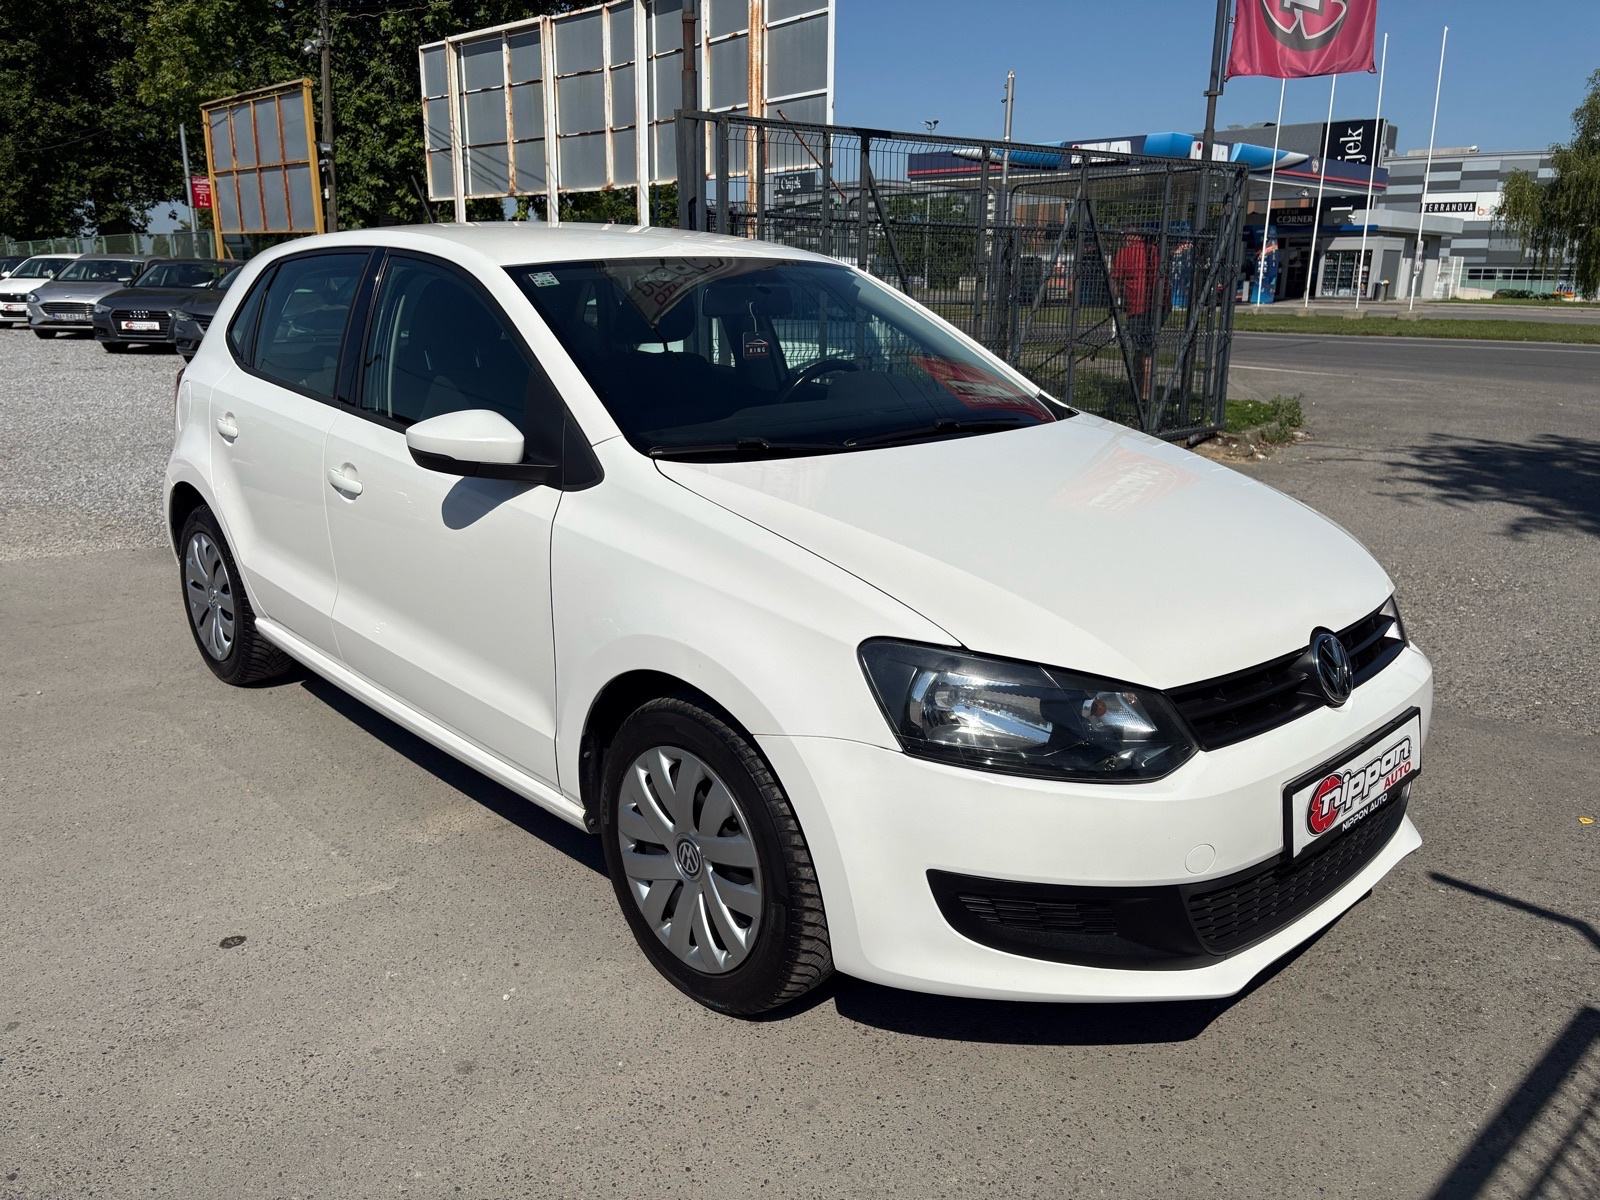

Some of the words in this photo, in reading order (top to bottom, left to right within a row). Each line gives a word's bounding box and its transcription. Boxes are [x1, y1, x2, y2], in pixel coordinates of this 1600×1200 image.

[1424, 203, 1474, 212] TERRANOVA
[1319, 737, 1411, 813] nippon
[1383, 761, 1411, 790] AUTO
[1342, 809, 1369, 832] NIPPON
[1369, 793, 1388, 812] AUTO
